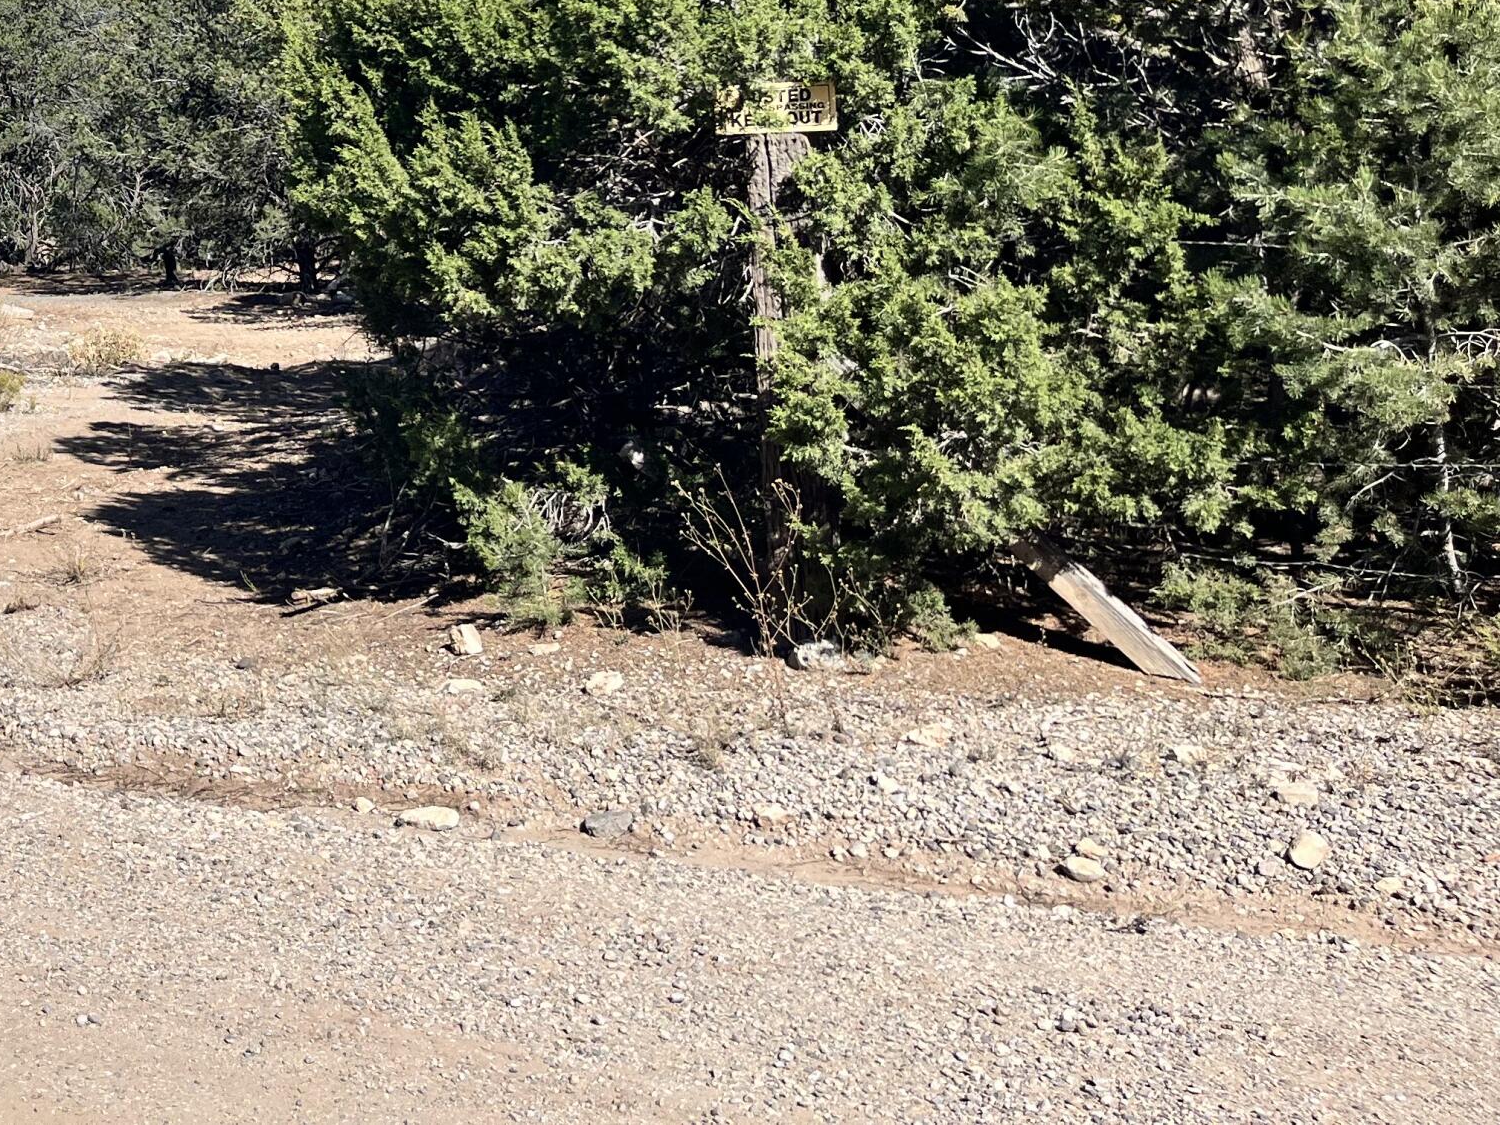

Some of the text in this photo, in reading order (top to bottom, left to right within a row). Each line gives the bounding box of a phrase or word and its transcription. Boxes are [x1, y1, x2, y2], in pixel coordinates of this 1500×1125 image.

[744, 88, 812, 104] STED
[752, 101, 825, 111] SPASSING
[787, 111, 822, 124] OUT
